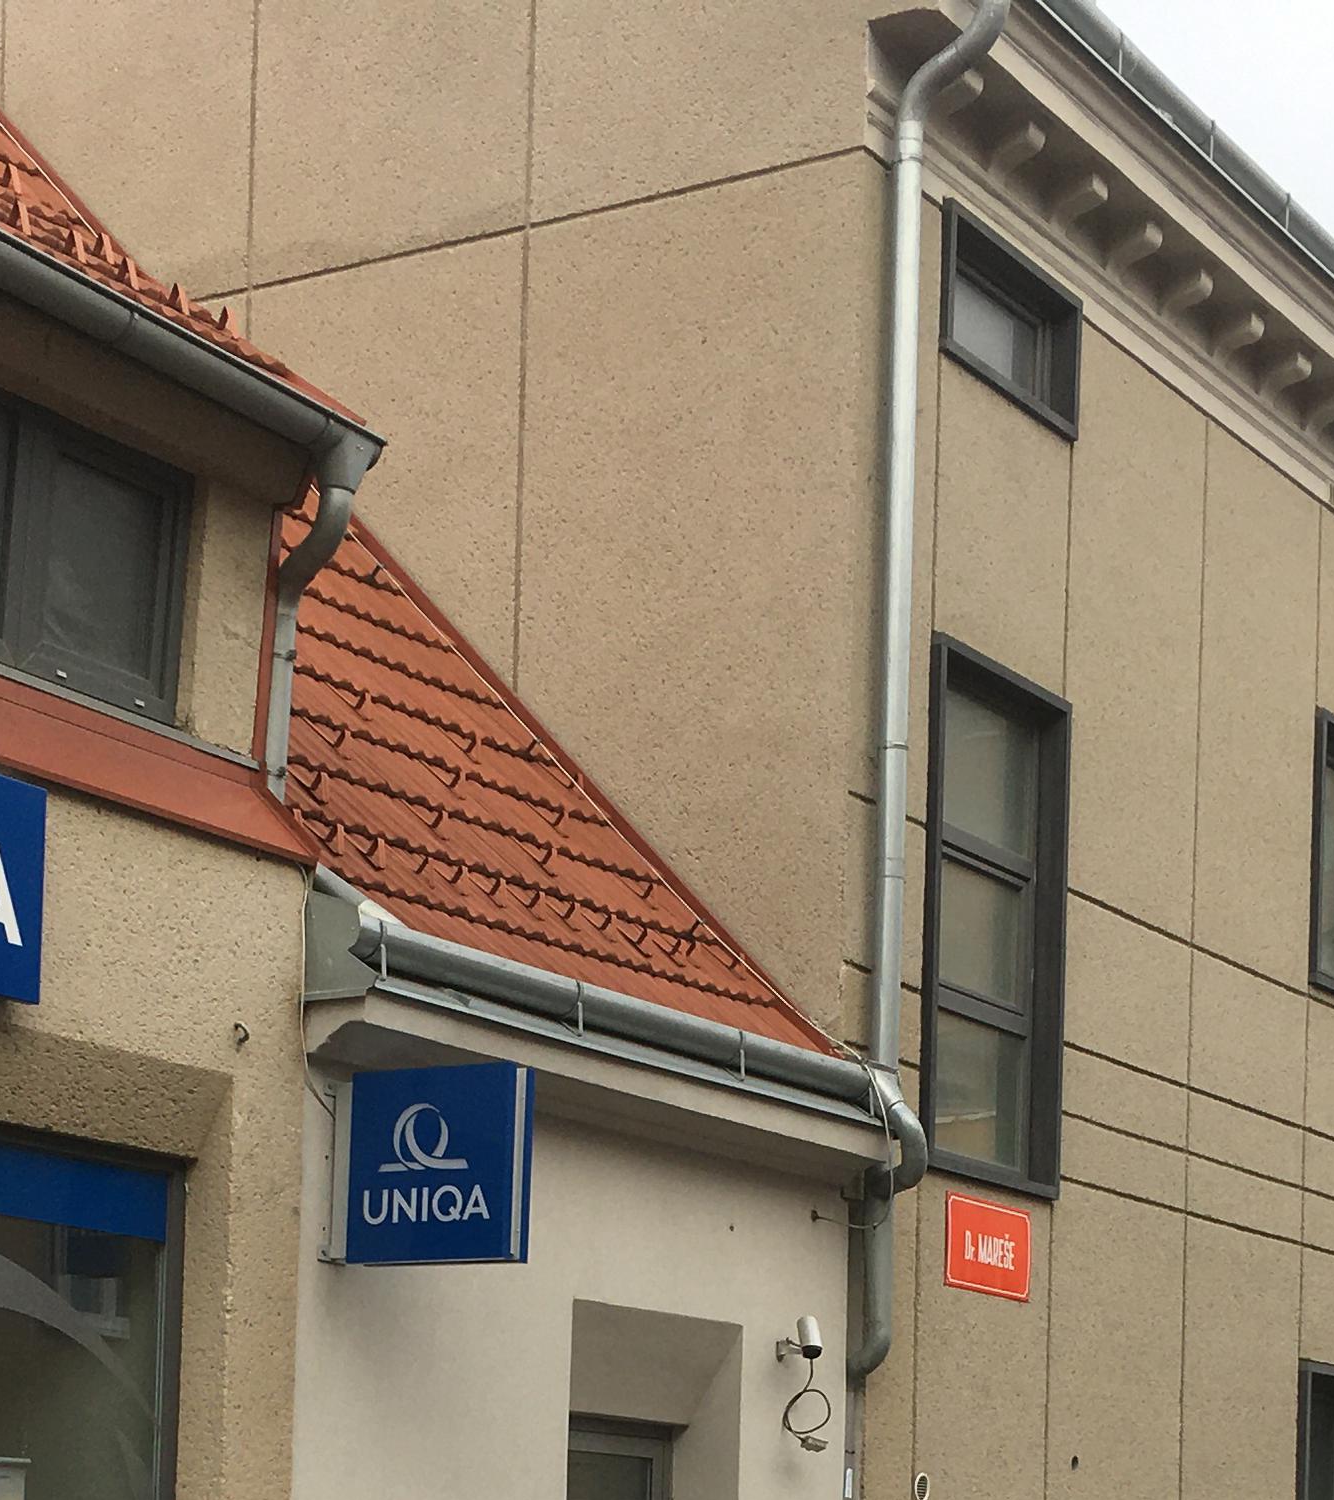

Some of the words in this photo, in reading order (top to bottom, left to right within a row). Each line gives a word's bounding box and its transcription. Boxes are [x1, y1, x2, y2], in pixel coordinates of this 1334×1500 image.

[362, 1184, 491, 1226] UNIQA
[964, 1230, 977, 1262] Dr.
[977, 1233, 1016, 1271] MAREŠE
